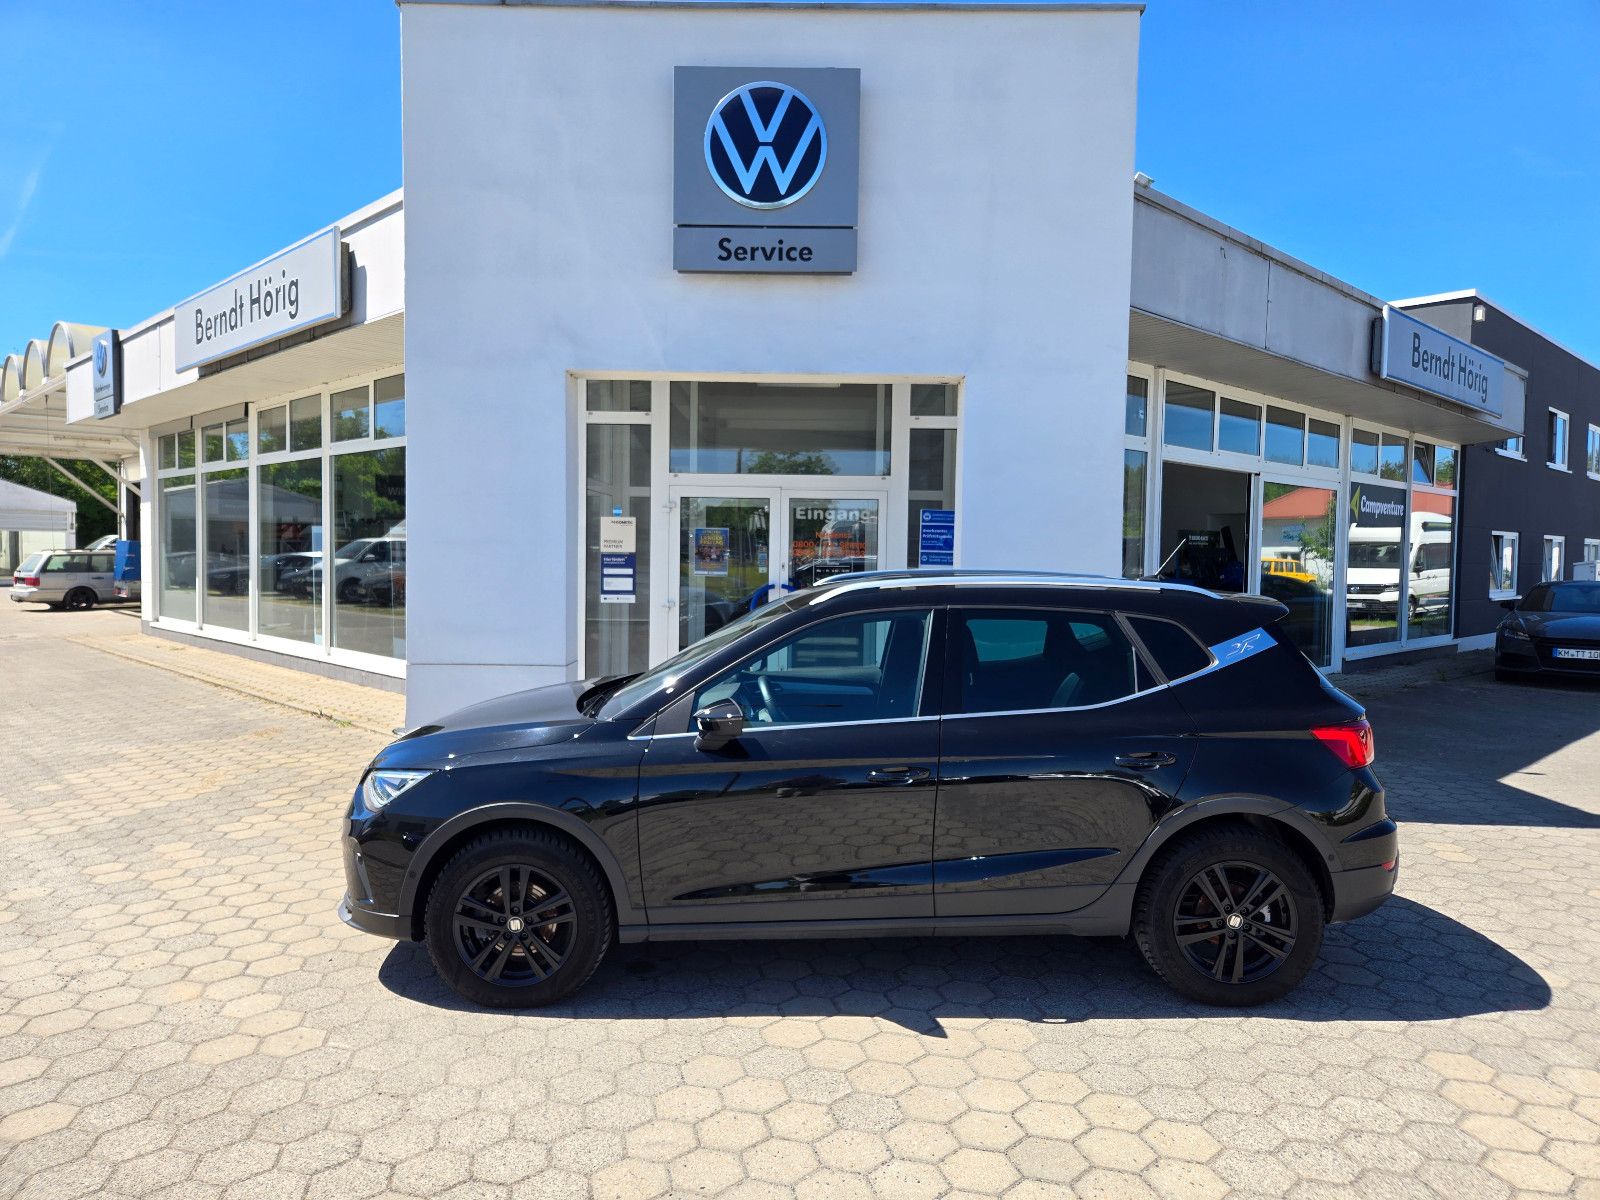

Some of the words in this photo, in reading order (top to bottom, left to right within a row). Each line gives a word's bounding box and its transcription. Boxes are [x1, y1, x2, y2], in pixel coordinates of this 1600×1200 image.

[717, 237, 813, 262] Service
[195, 288, 245, 345] Berndt
[249, 269, 299, 320] Hörig
[1411, 331, 1455, 382] Berndt
[1457, 352, 1488, 404] Hörig
[795, 506, 871, 523] Eingang
[1360, 495, 1404, 518] Campventure
[1587, 651, 1600, 659] 10
